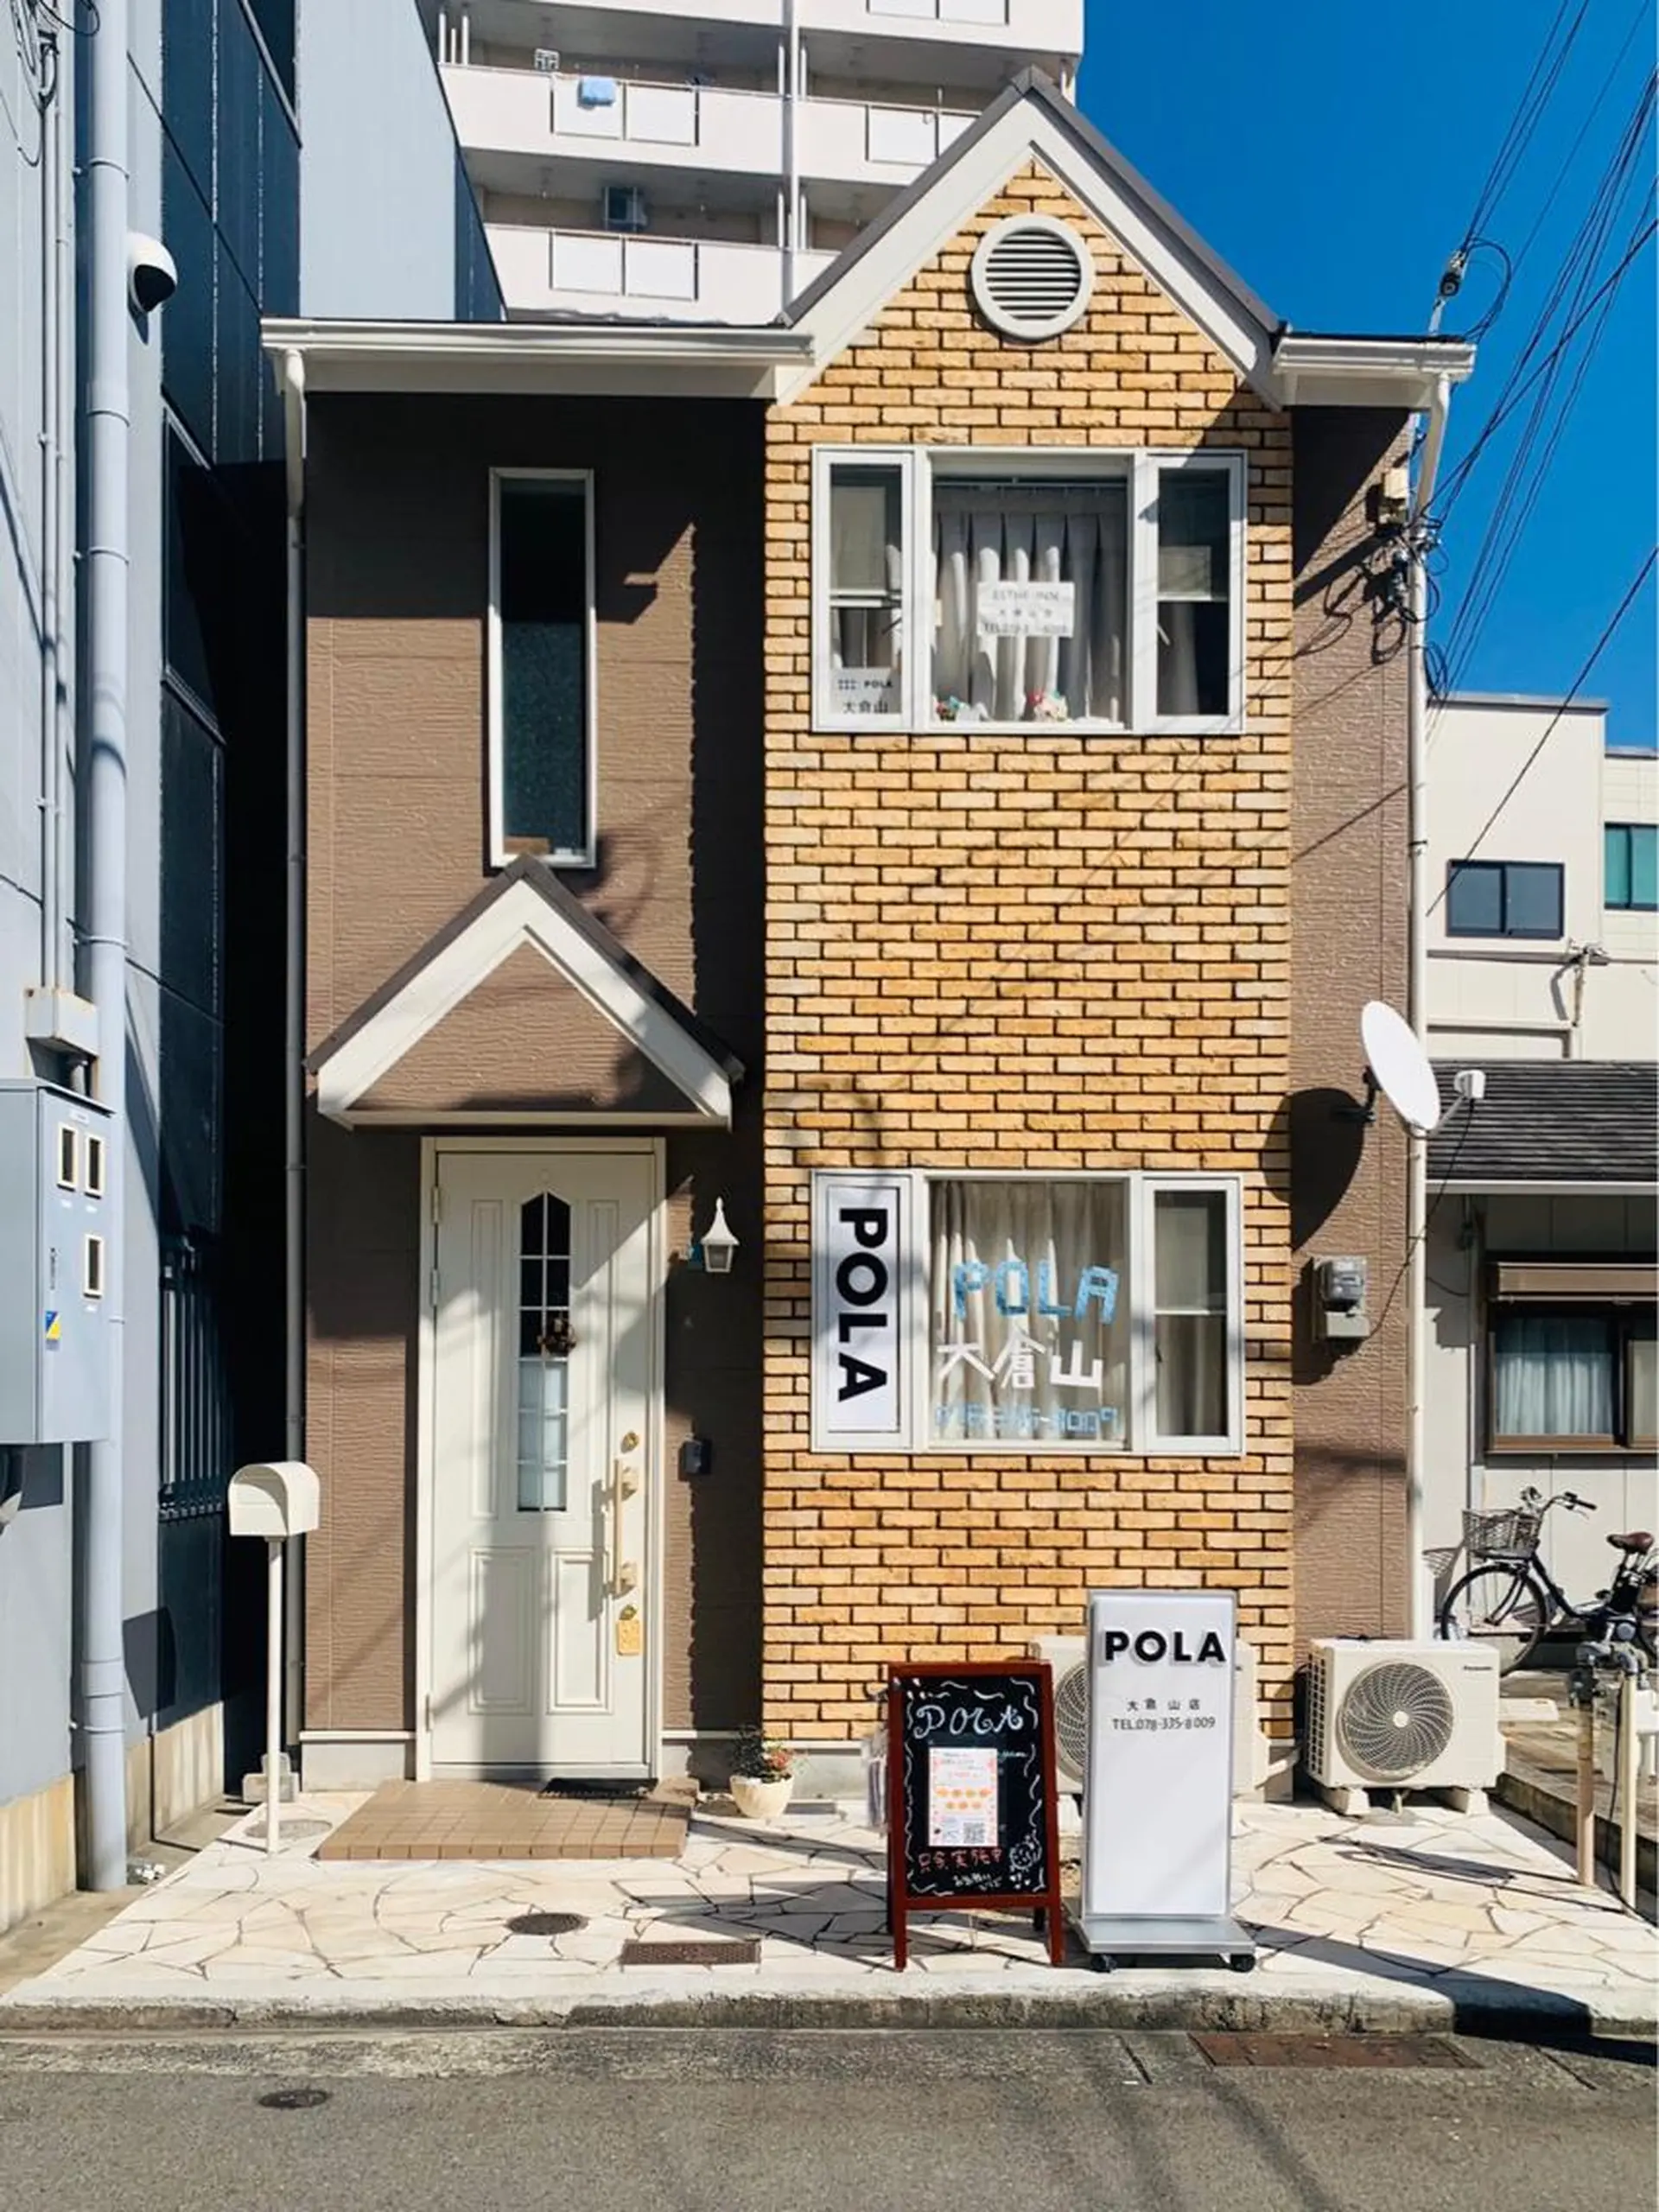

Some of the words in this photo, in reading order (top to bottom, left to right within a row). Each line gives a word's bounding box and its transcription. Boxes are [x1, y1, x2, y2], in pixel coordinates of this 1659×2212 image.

[836, 1207, 889, 1403] POLA
[954, 1259, 1119, 1325] POLA
[936, 1324, 1103, 1390] 大倉山
[1105, 1630, 1227, 1662] POLA
[912, 1704, 1024, 1739] POLA
[1127, 1697, 1201, 1713] 大倉山店
